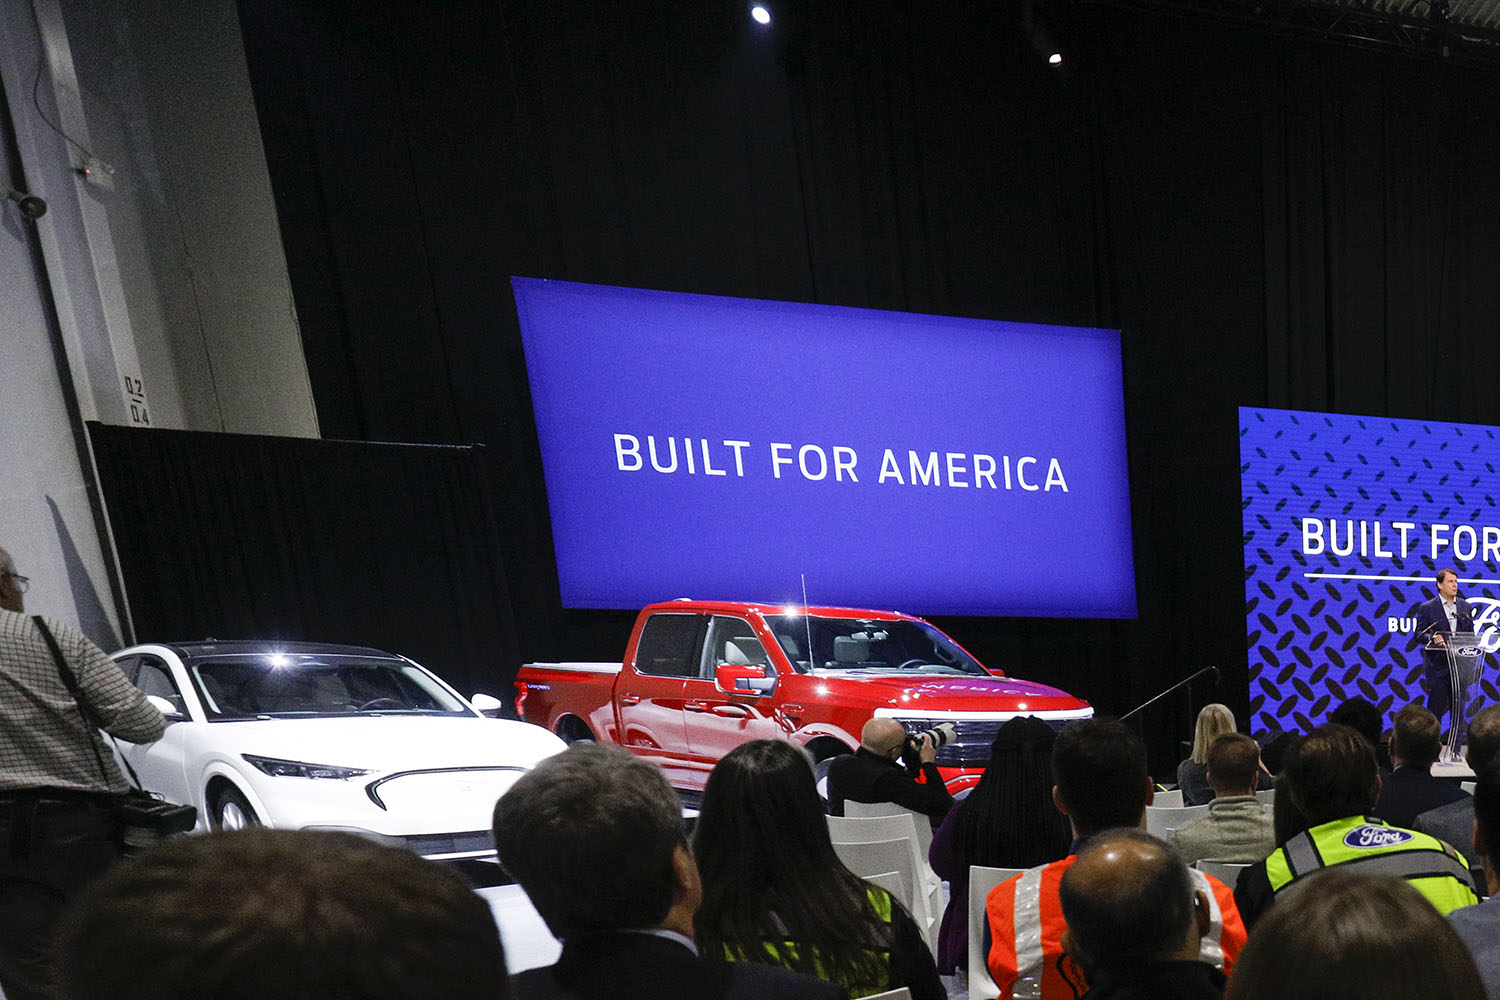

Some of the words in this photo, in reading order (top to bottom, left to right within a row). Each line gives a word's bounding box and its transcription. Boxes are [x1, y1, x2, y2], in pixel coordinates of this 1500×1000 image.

[613, 433, 752, 478] BUILT
[770, 442, 860, 483] FOR
[878, 448, 1070, 493] AMERICA
[1302, 517, 1416, 559] BUILT
[1388, 617, 1418, 633] BUI
[1360, 826, 1402, 845] Ford
